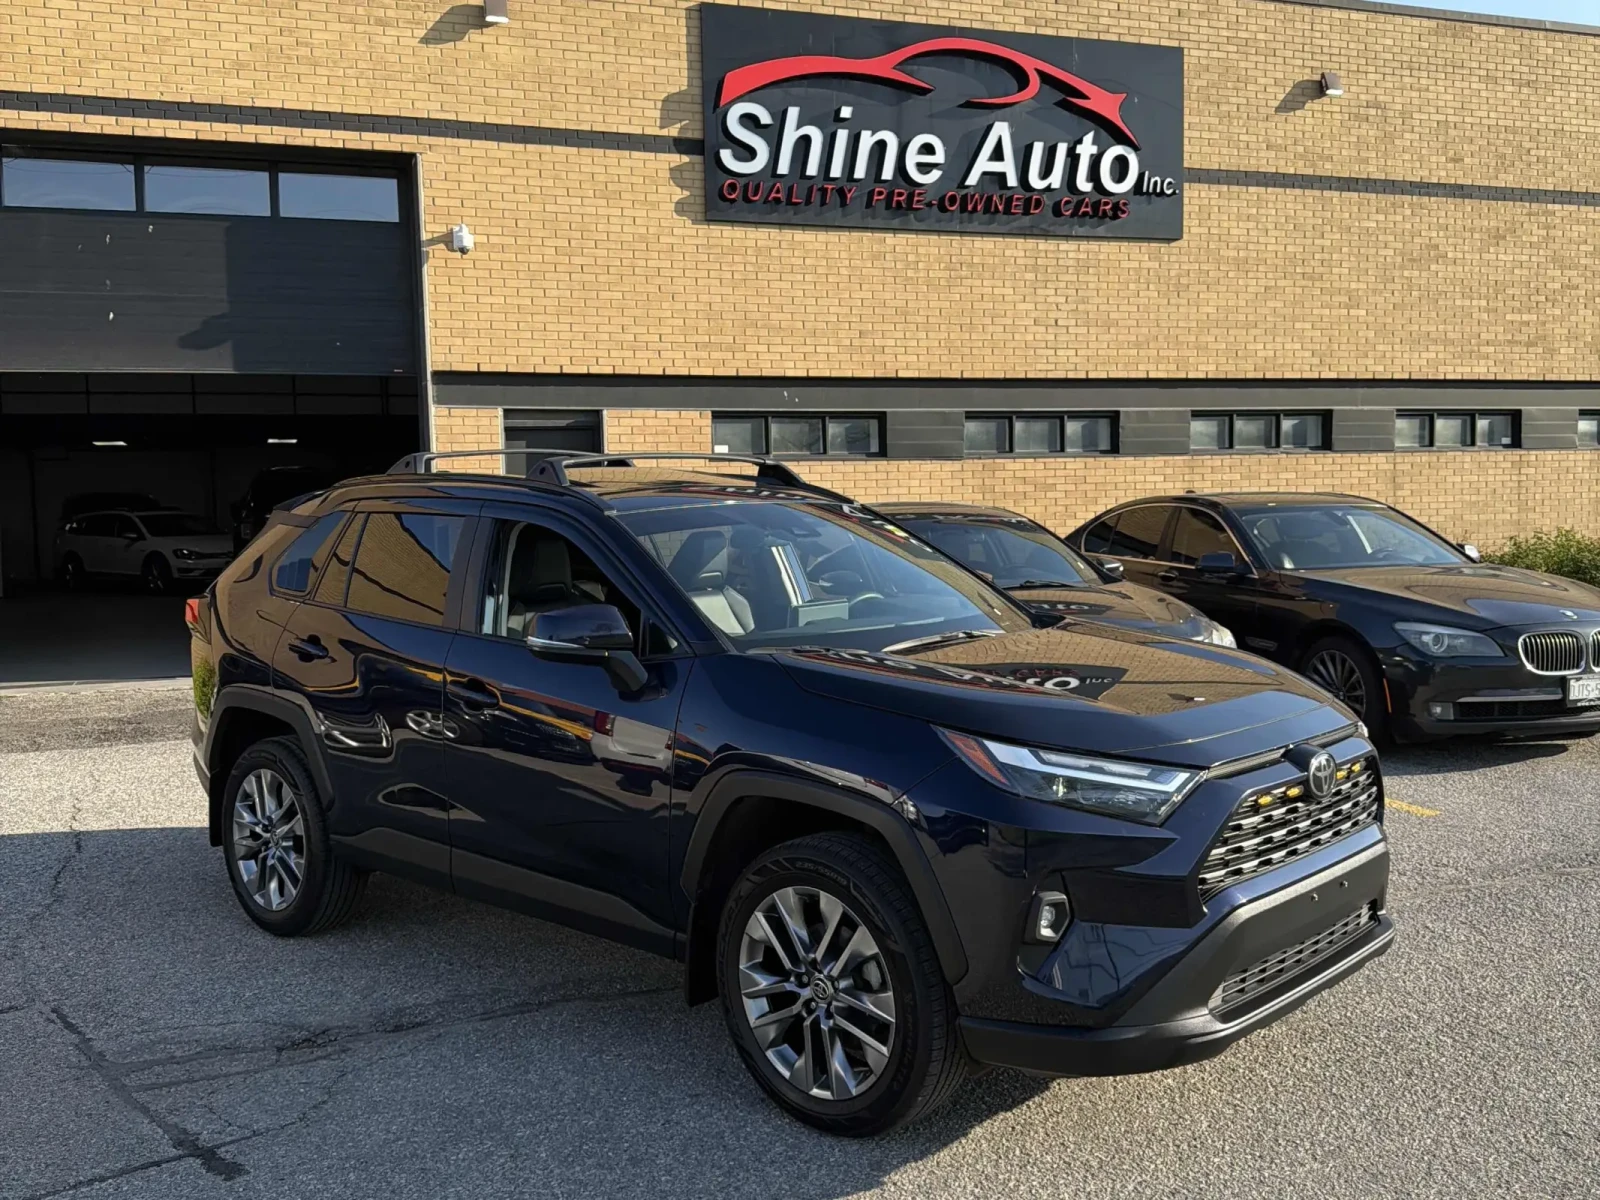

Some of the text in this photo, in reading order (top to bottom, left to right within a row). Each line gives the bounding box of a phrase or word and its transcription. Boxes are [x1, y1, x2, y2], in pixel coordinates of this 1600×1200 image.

[719, 102, 1180, 195] Shine Auto Inc.
[722, 178, 1131, 218] QUALITY PRE-OWNED CARS
